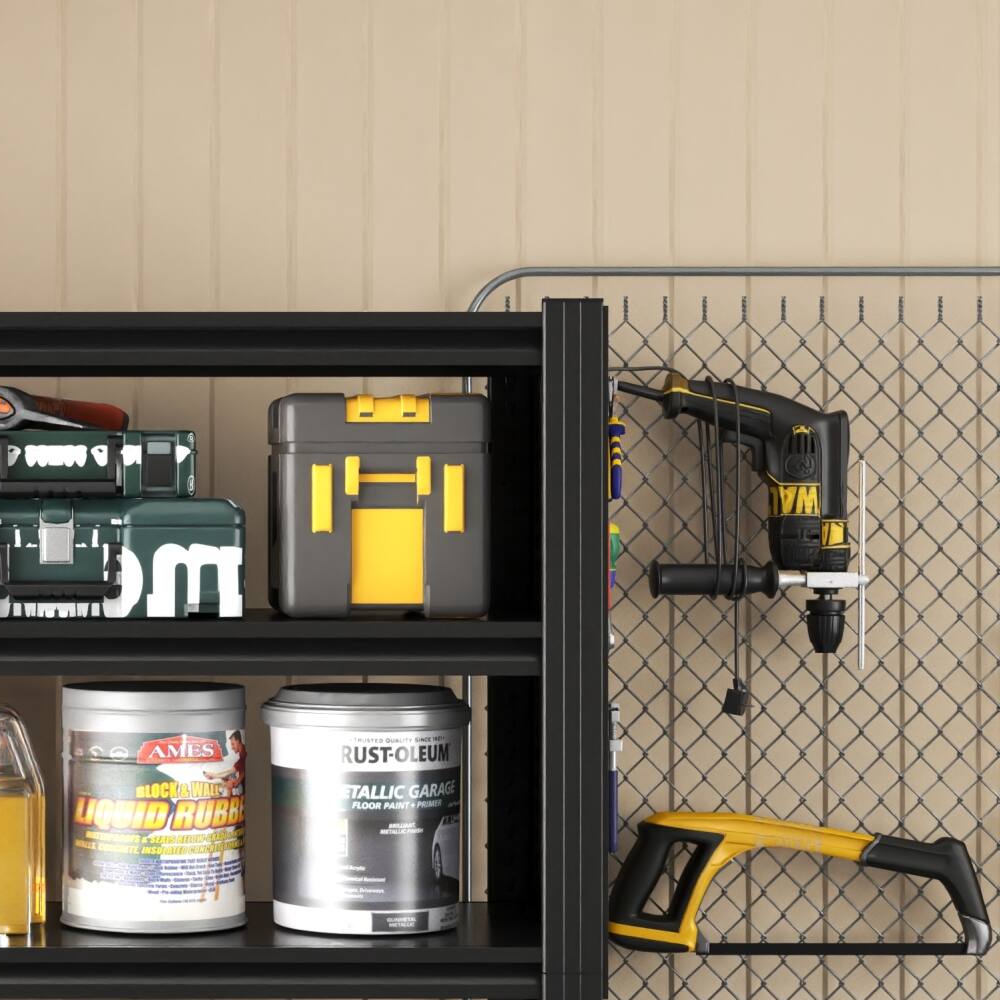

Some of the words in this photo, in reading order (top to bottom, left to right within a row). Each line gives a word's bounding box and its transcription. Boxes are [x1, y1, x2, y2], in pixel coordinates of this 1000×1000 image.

[148, 742, 214, 759] AMES
[341, 743, 450, 764] RUST-OLEUM
[136, 782, 178, 799] BLOCK
[180, 782, 190, 798] &
[191, 780, 221, 798] WALL
[343, 784, 406, 800] ETALLIC
[408, 780, 456, 799] GARAGE
[74, 796, 171, 831] LIQUID
[352, 801, 382, 810] FLOOR
[383, 801, 410, 810] PAINT
[416, 800, 443, 808] PRIMER
